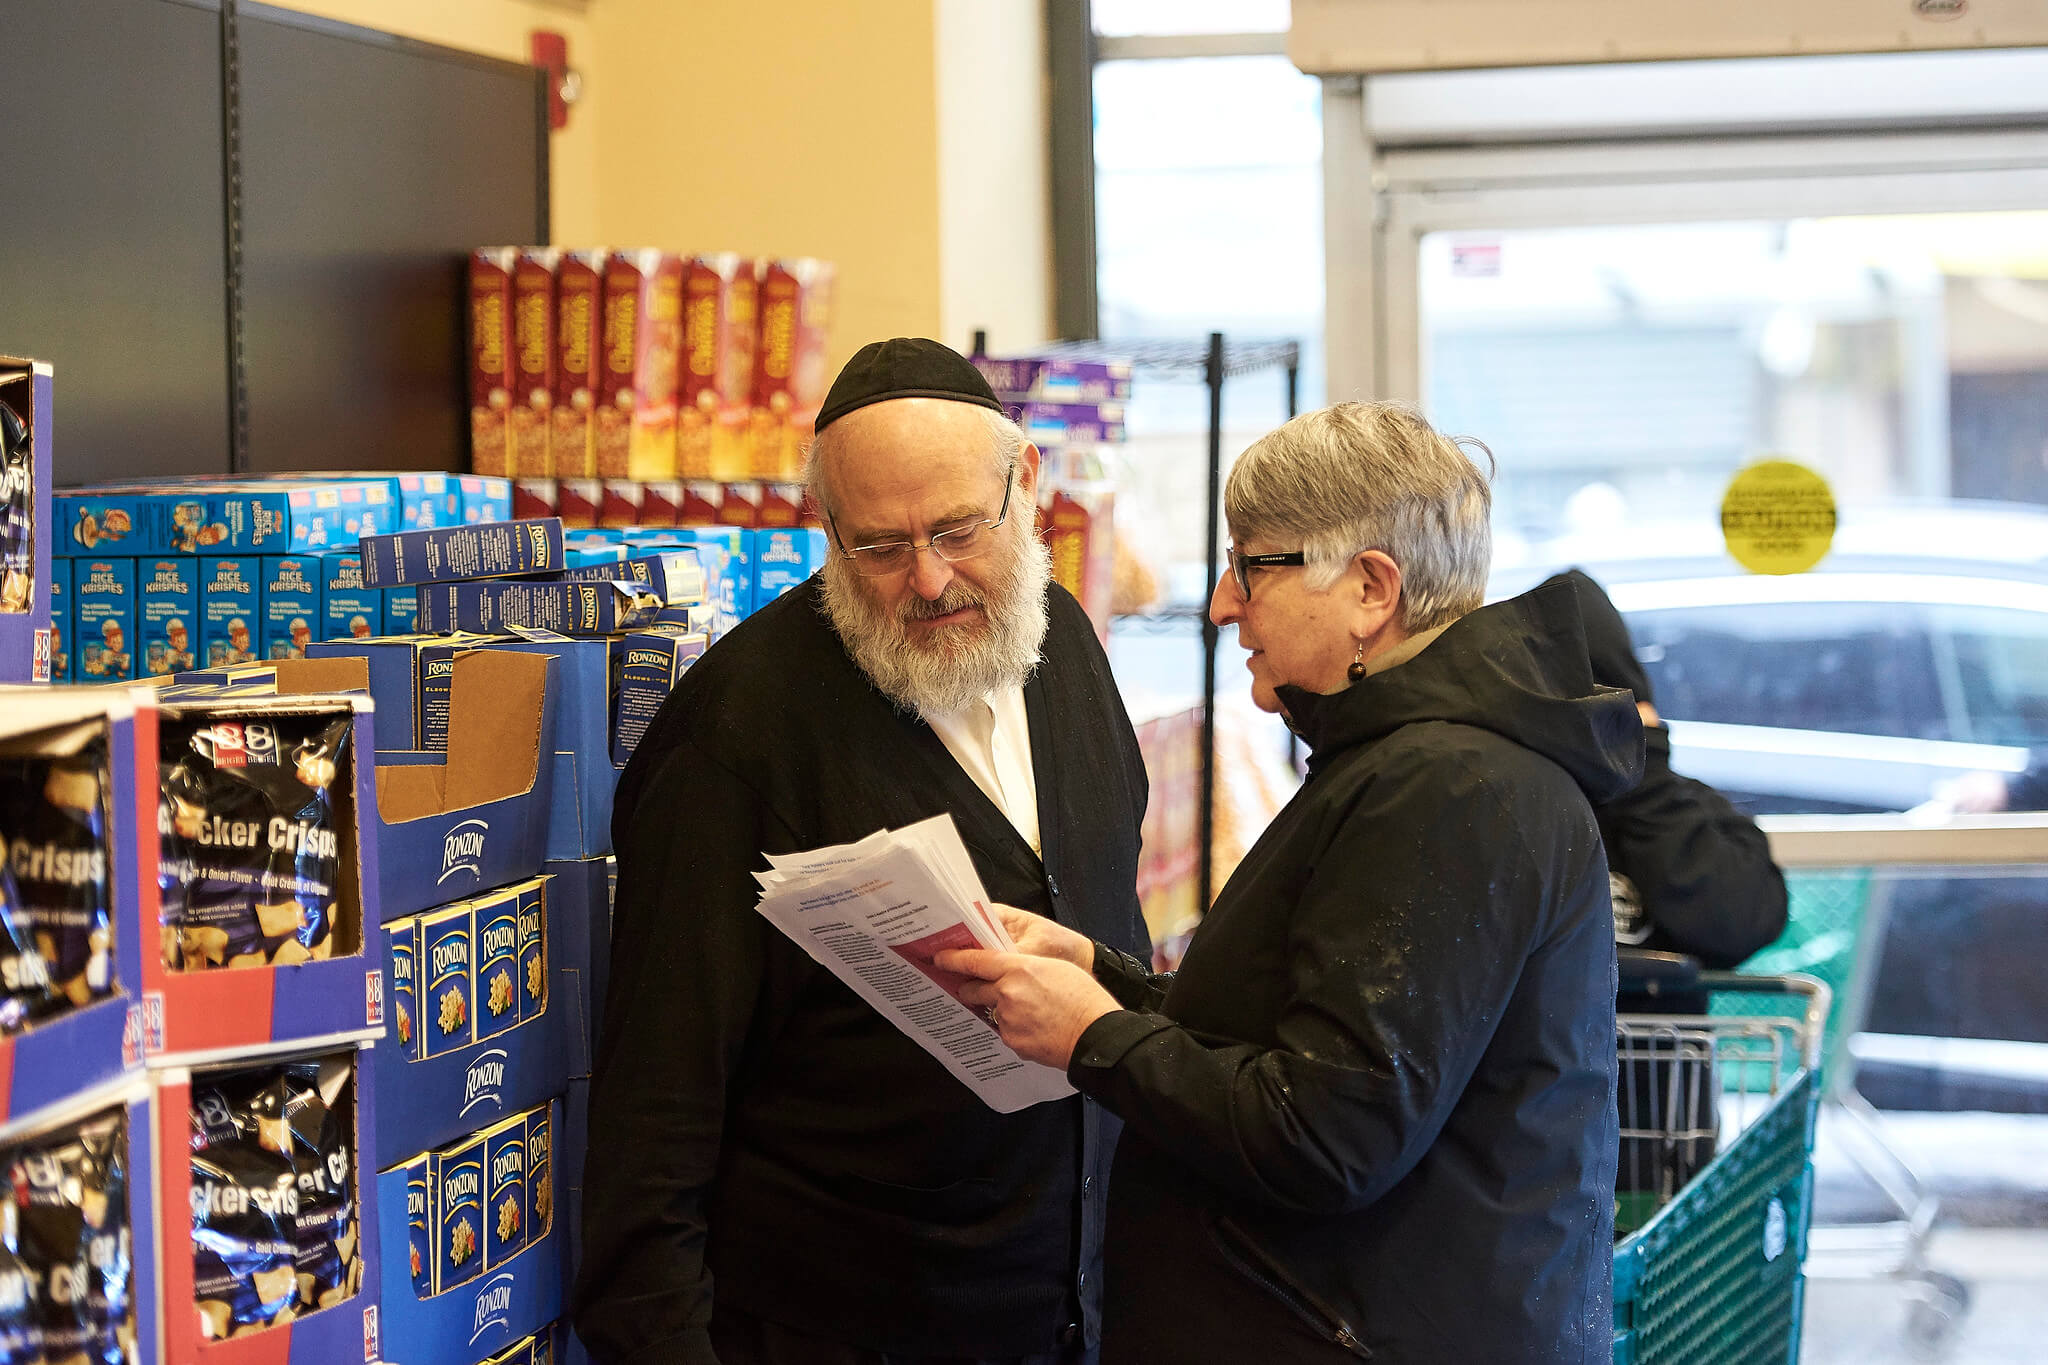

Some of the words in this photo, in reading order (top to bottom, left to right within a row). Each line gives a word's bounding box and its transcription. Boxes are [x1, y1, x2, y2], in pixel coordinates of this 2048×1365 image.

[531, 525, 545, 567] RONZONI
[91, 573, 114, 584] RICE
[145, 582, 188, 594] KRISPIES
[155, 572, 179, 582] RICE
[207, 582, 250, 594] KRISPIES
[217, 572, 241, 582] RICE
[269, 581, 313, 594] KRISPIES
[279, 571, 303, 582] RICE
[81, 583, 123, 595] KRISPIES
[582, 587, 595, 629] RONZONI
[428, 662, 453, 676] RONZ
[628, 651, 669, 666] RONZONI
[268, 817, 336, 860] Crisps
[442, 831, 485, 873] RONZONI
[208, 868, 229, 881] Onion
[230, 871, 252, 884] Flavor
[483, 926, 515, 962] RONZONI
[394, 957, 411, 979] ZONI
[433, 942, 467, 979] RONZONI
[464, 1061, 504, 1104] RONZONI
[530, 1131, 548, 1167] RONZ
[493, 1151, 523, 1190] RONZONI
[408, 1191, 424, 1215] ZONI
[445, 1172, 478, 1212] RONZONI
[474, 1286, 511, 1333] RONZONI
